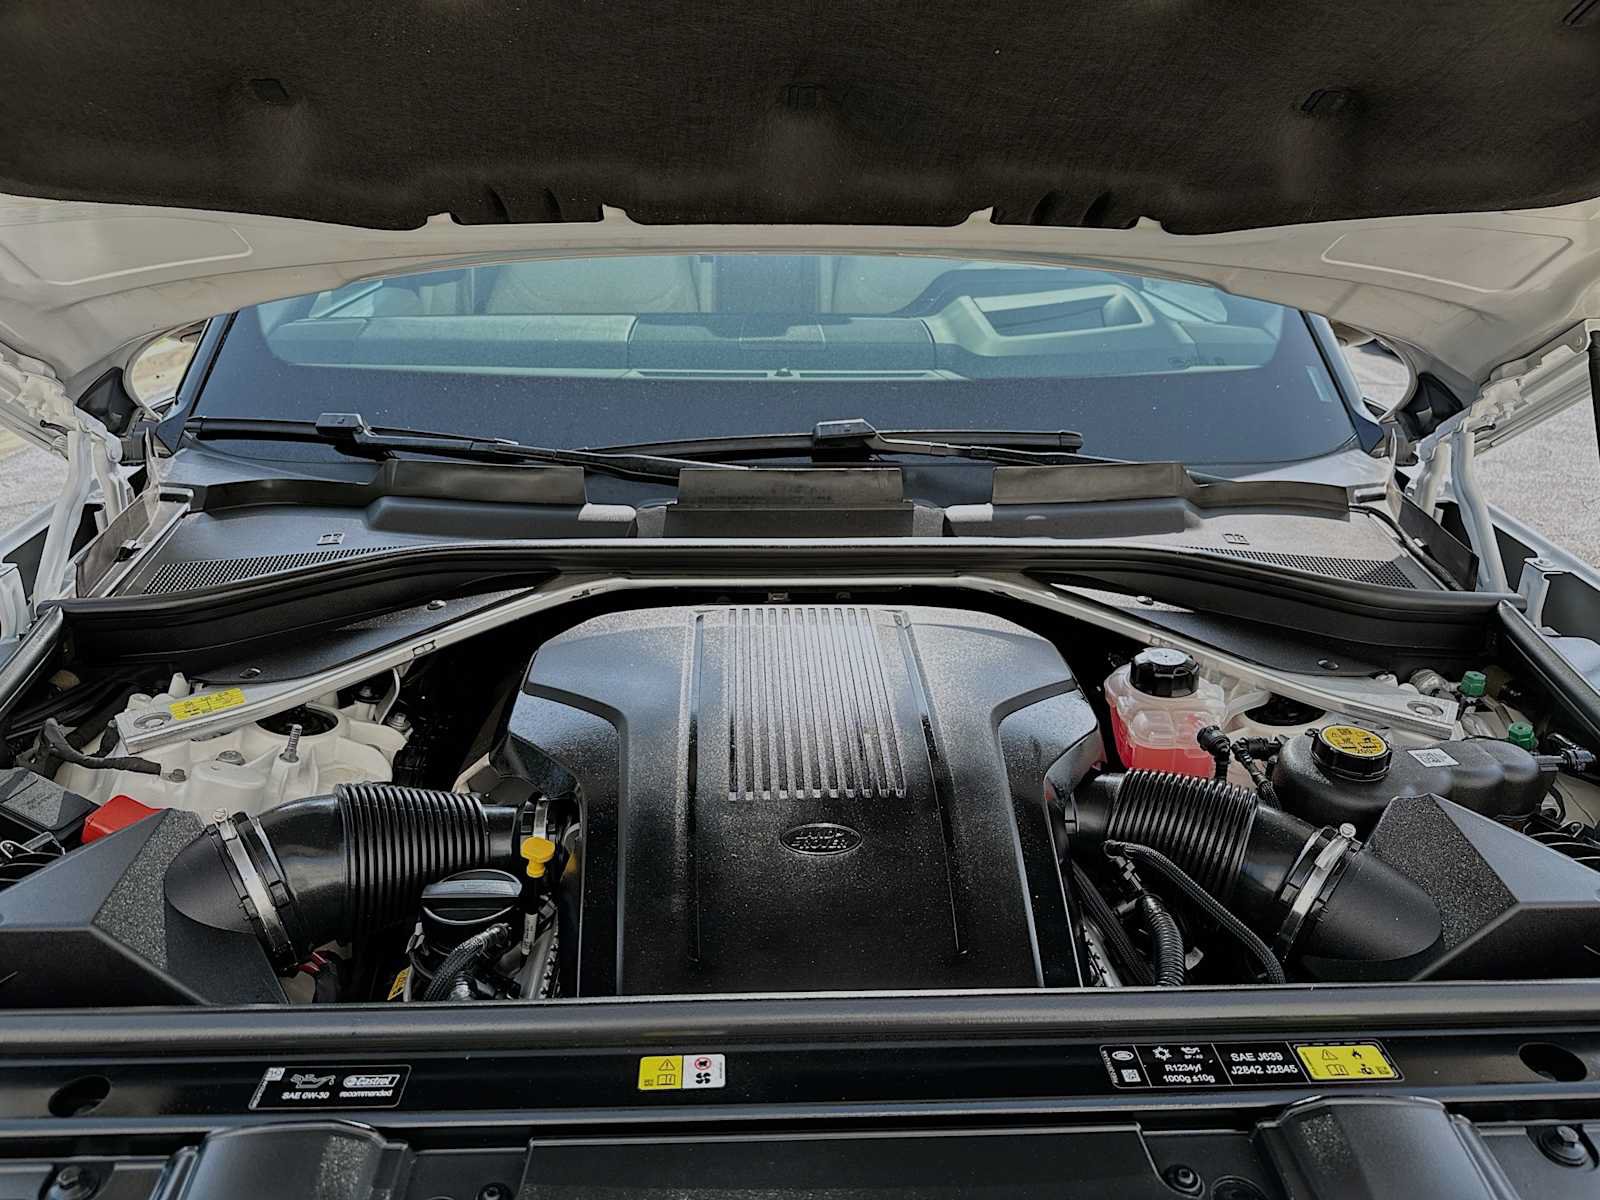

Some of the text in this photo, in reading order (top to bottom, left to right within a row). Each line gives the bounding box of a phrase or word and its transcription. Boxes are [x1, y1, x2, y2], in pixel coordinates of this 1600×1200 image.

[1230, 1053, 1256, 1061] SAE
[1231, 1064, 1298, 1075] J2842 J2845
[1163, 1075, 1192, 1083] 1000g
[281, 1091, 301, 1100] SAE
[339, 1089, 393, 1098] recommended
